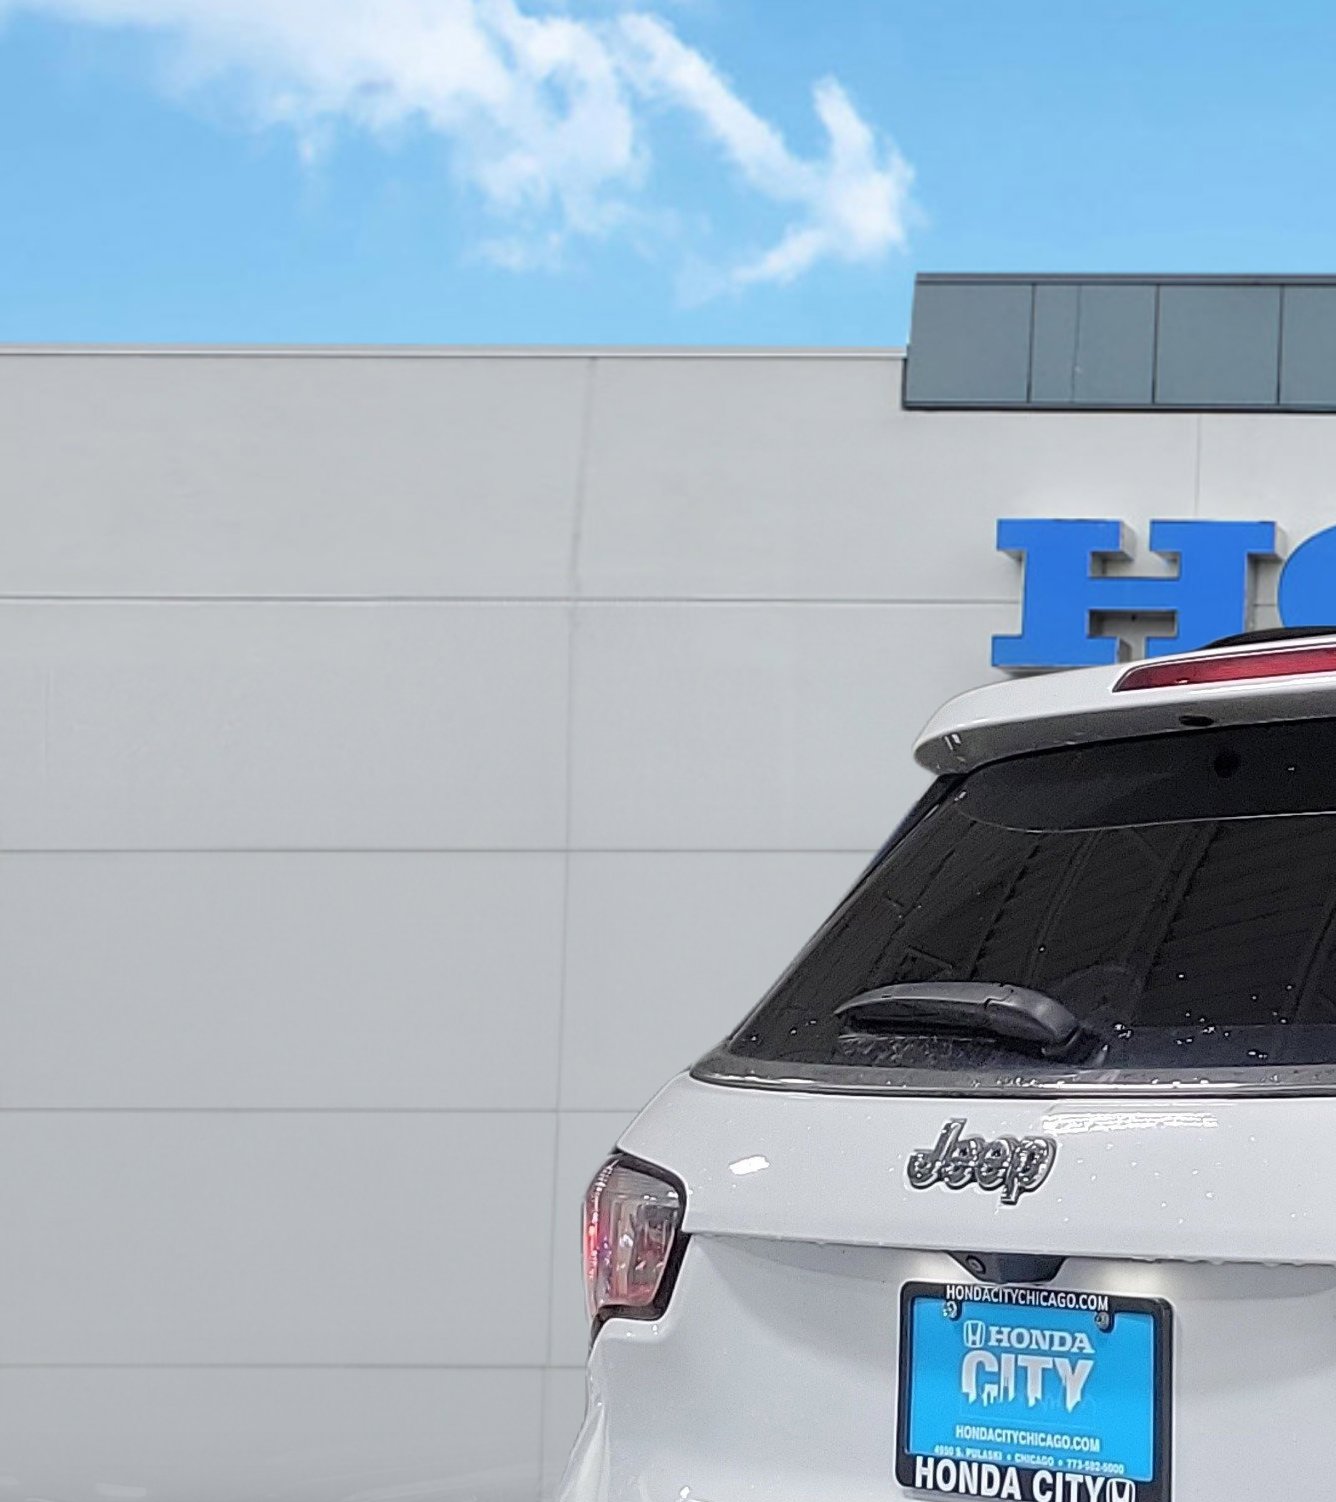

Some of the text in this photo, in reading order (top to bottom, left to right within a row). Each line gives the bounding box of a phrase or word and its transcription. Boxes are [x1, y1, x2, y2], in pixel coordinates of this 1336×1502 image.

[907, 1118, 1057, 1206] Jeep
[945, 1284, 1109, 1312] HONDACITYCHICAGO.COM
[988, 1326, 1096, 1354] HONDA
[961, 1350, 1094, 1414] CITY
[955, 1425, 1100, 1452] HONDACITYCHICAGO.COM
[1014, 1453, 1054, 1466] CHICAGO
[914, 1455, 1022, 1500] HONDA
